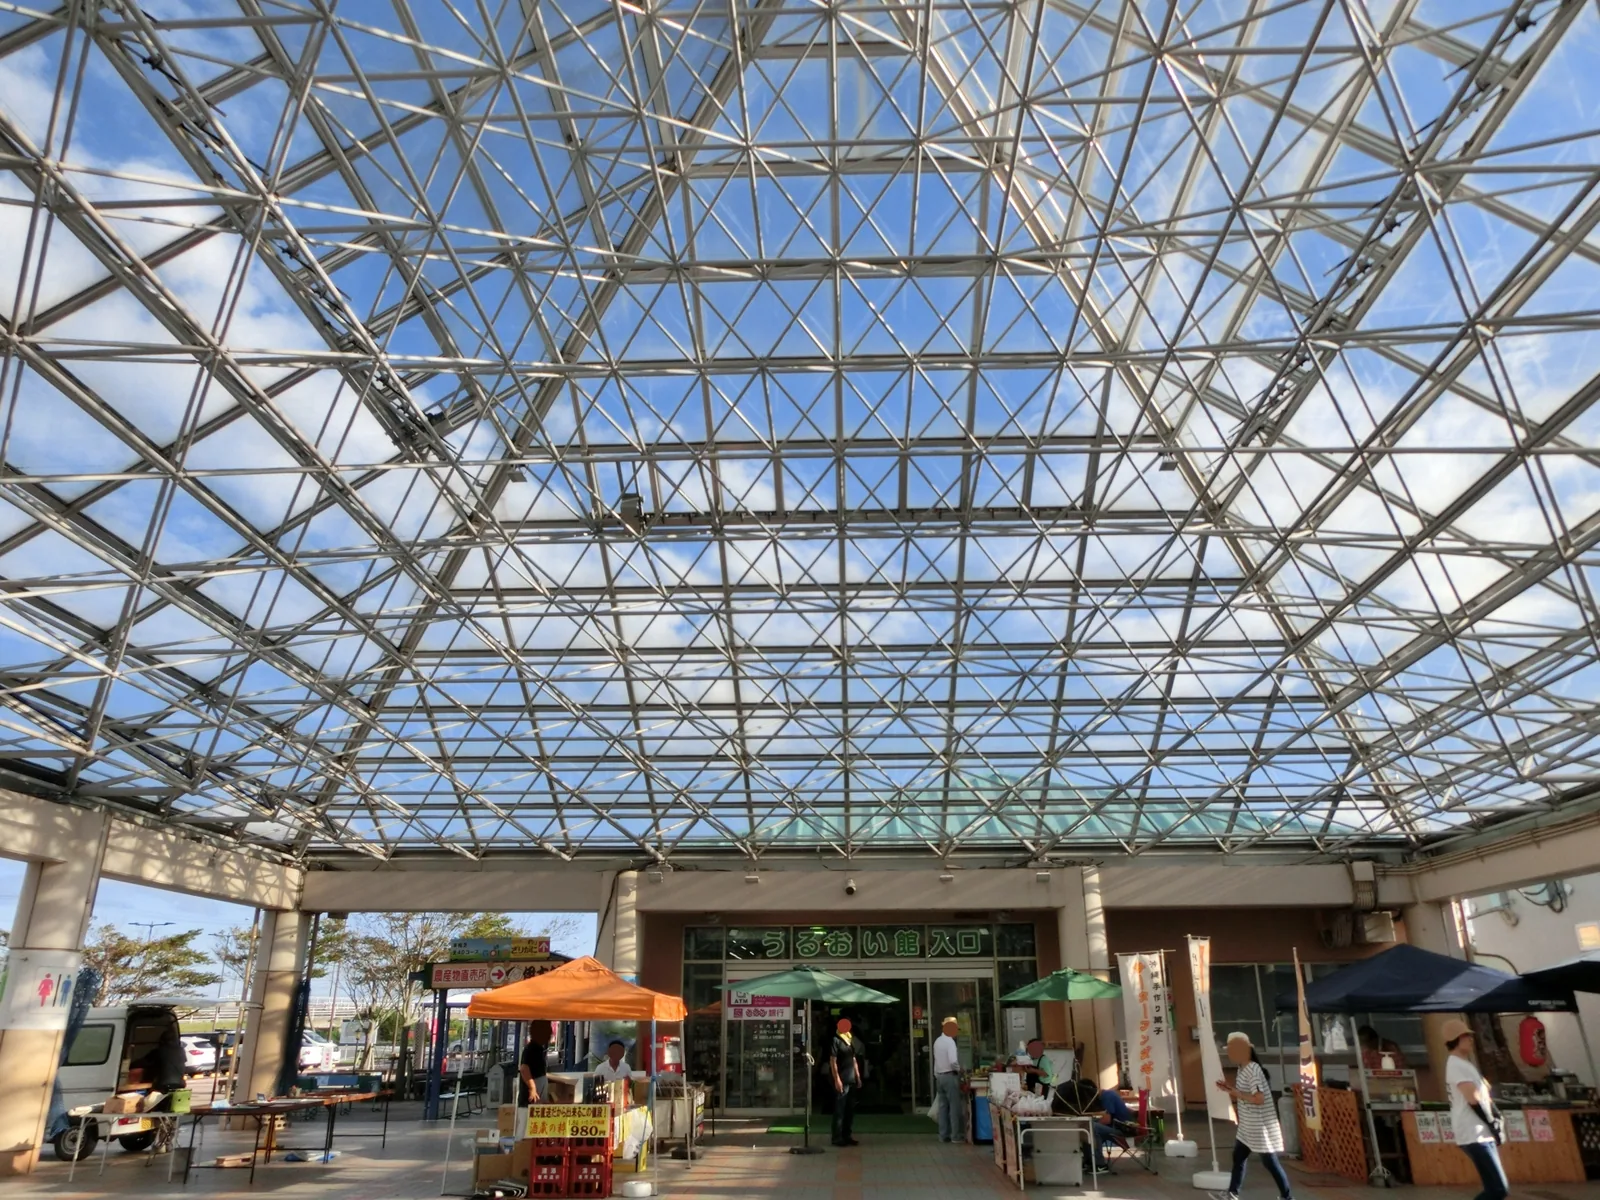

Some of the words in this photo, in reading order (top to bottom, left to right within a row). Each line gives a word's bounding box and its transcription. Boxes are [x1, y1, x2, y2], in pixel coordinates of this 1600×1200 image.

[434, 968, 488, 982] 農産物直売所
[1149, 960, 1163, 1035] 沖縄手作り菓子
